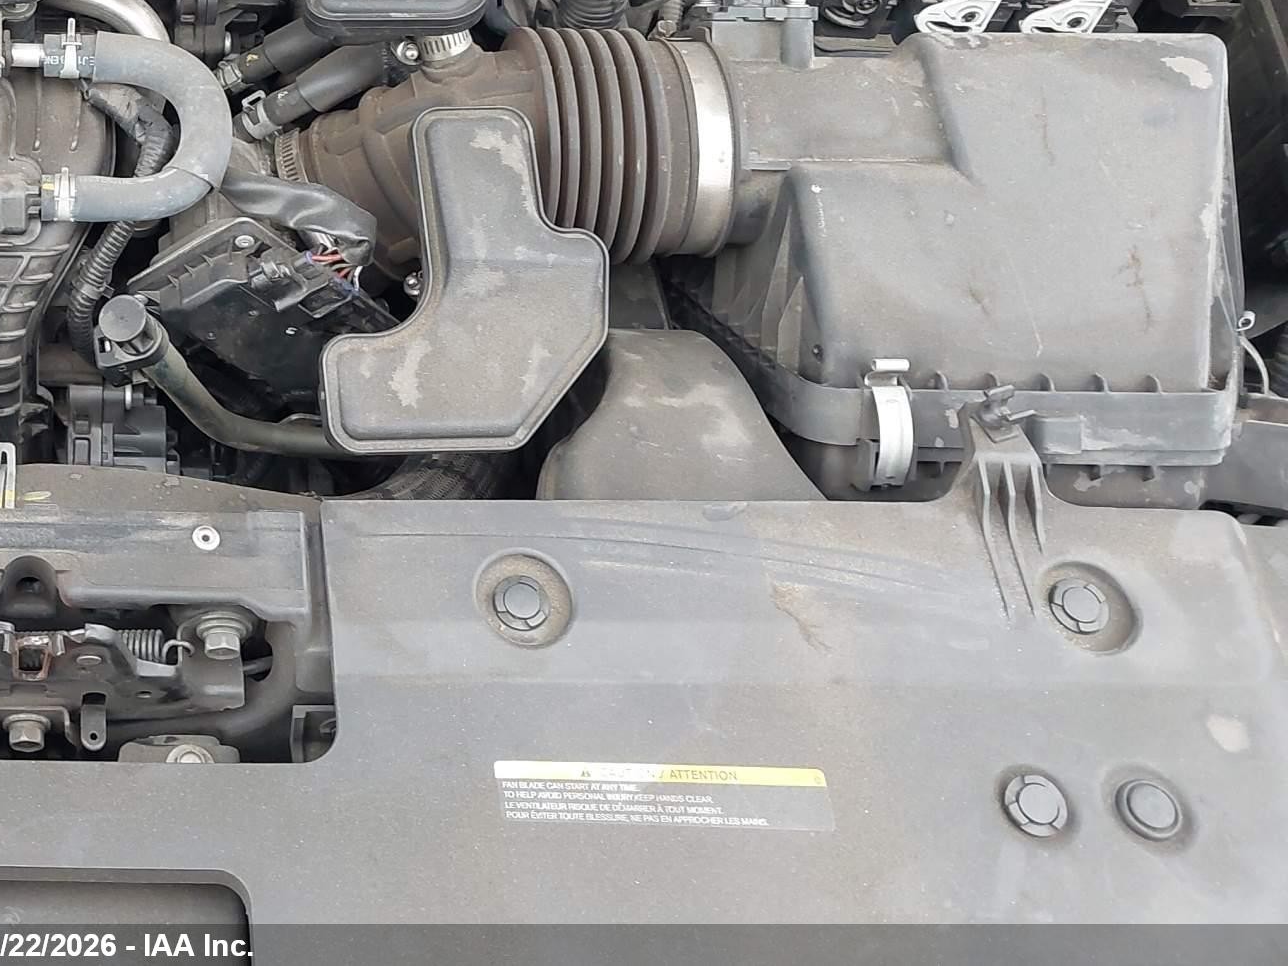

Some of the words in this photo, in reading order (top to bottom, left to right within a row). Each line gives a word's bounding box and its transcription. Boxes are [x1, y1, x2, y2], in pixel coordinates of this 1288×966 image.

[669, 769, 738, 781] ATTENTION
[518, 781, 545, 789] BLADE
[546, 782, 564, 790] CAN
[504, 790, 516, 798] TO
[516, 791, 537, 799] HELP
[537, 791, 562, 799] AVOID
[563, 792, 606, 800] PERSONAL
[656, 794, 685, 803] HANDS
[506, 810, 530, 818] POUR
[559, 811, 585, 820] TOUTE
[643, 814, 660, 823] PAS
[661, 815, 673, 823] EN
